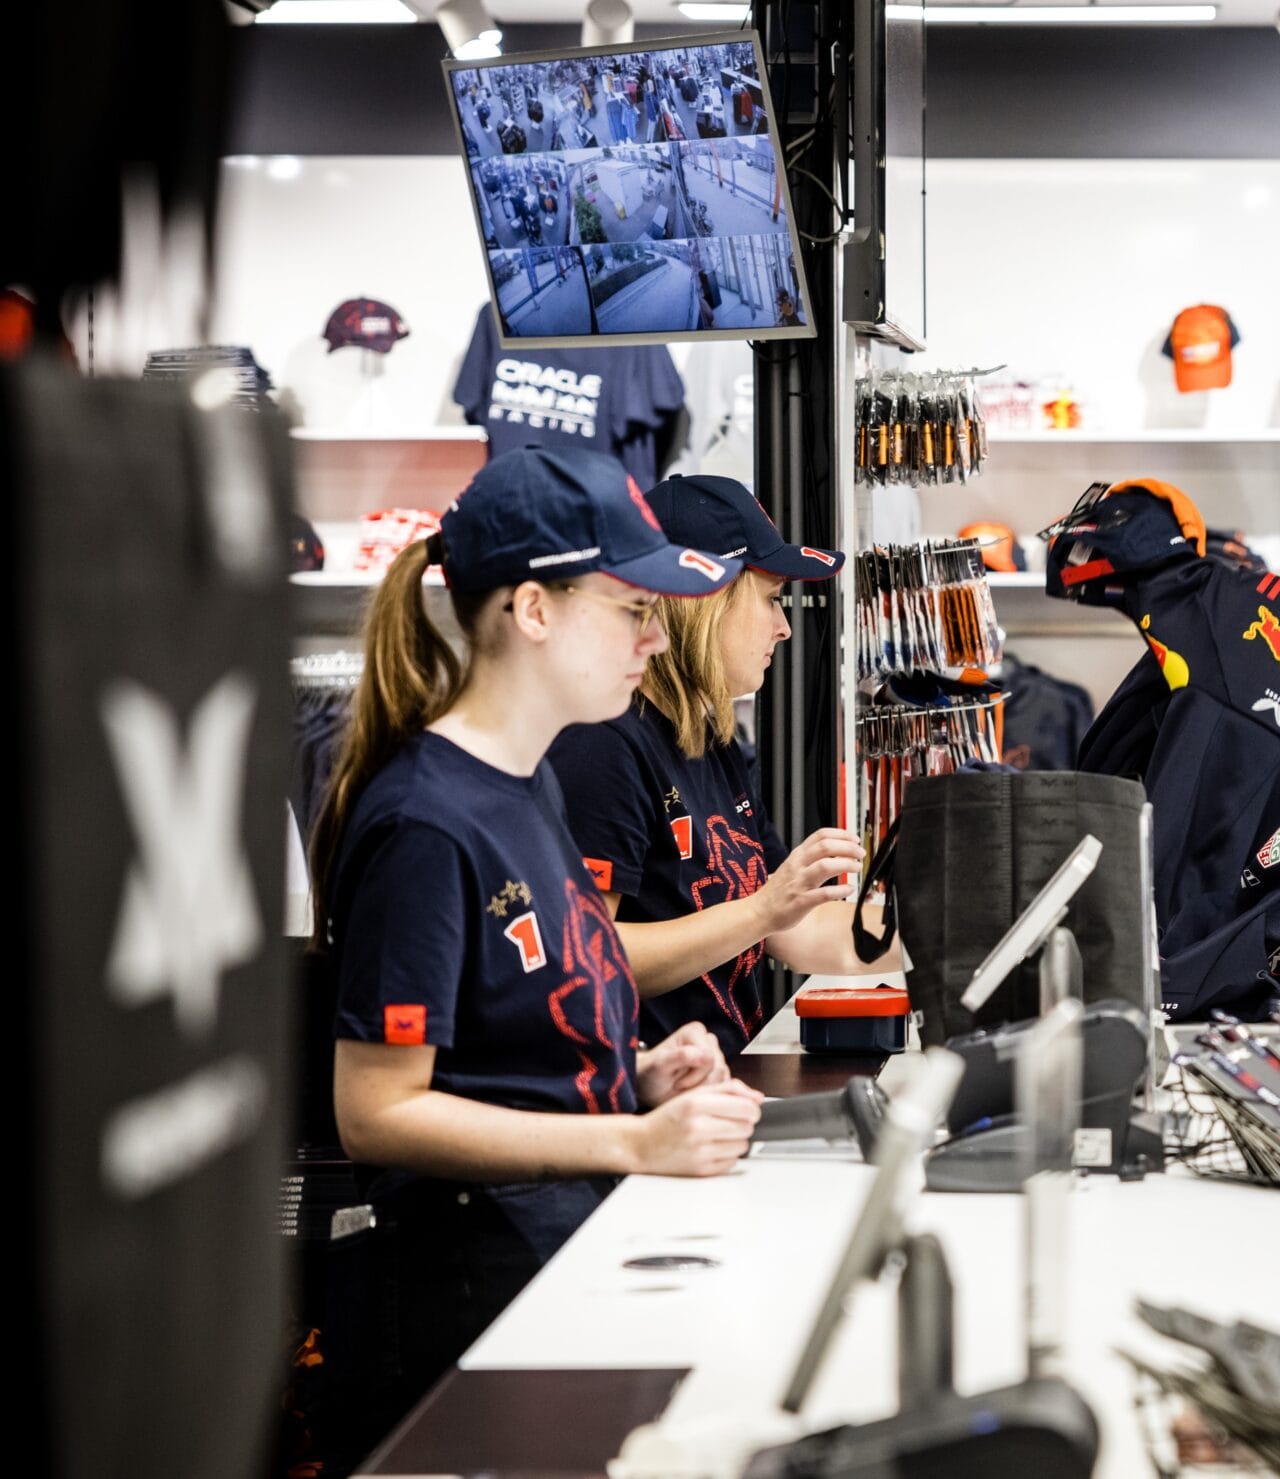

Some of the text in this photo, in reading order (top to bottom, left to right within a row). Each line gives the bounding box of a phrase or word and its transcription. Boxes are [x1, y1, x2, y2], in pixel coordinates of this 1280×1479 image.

[496, 359, 602, 398] ORACLE
[678, 549, 727, 583] 1
[801, 546, 837, 567] 1
[503, 910, 549, 974] 1
